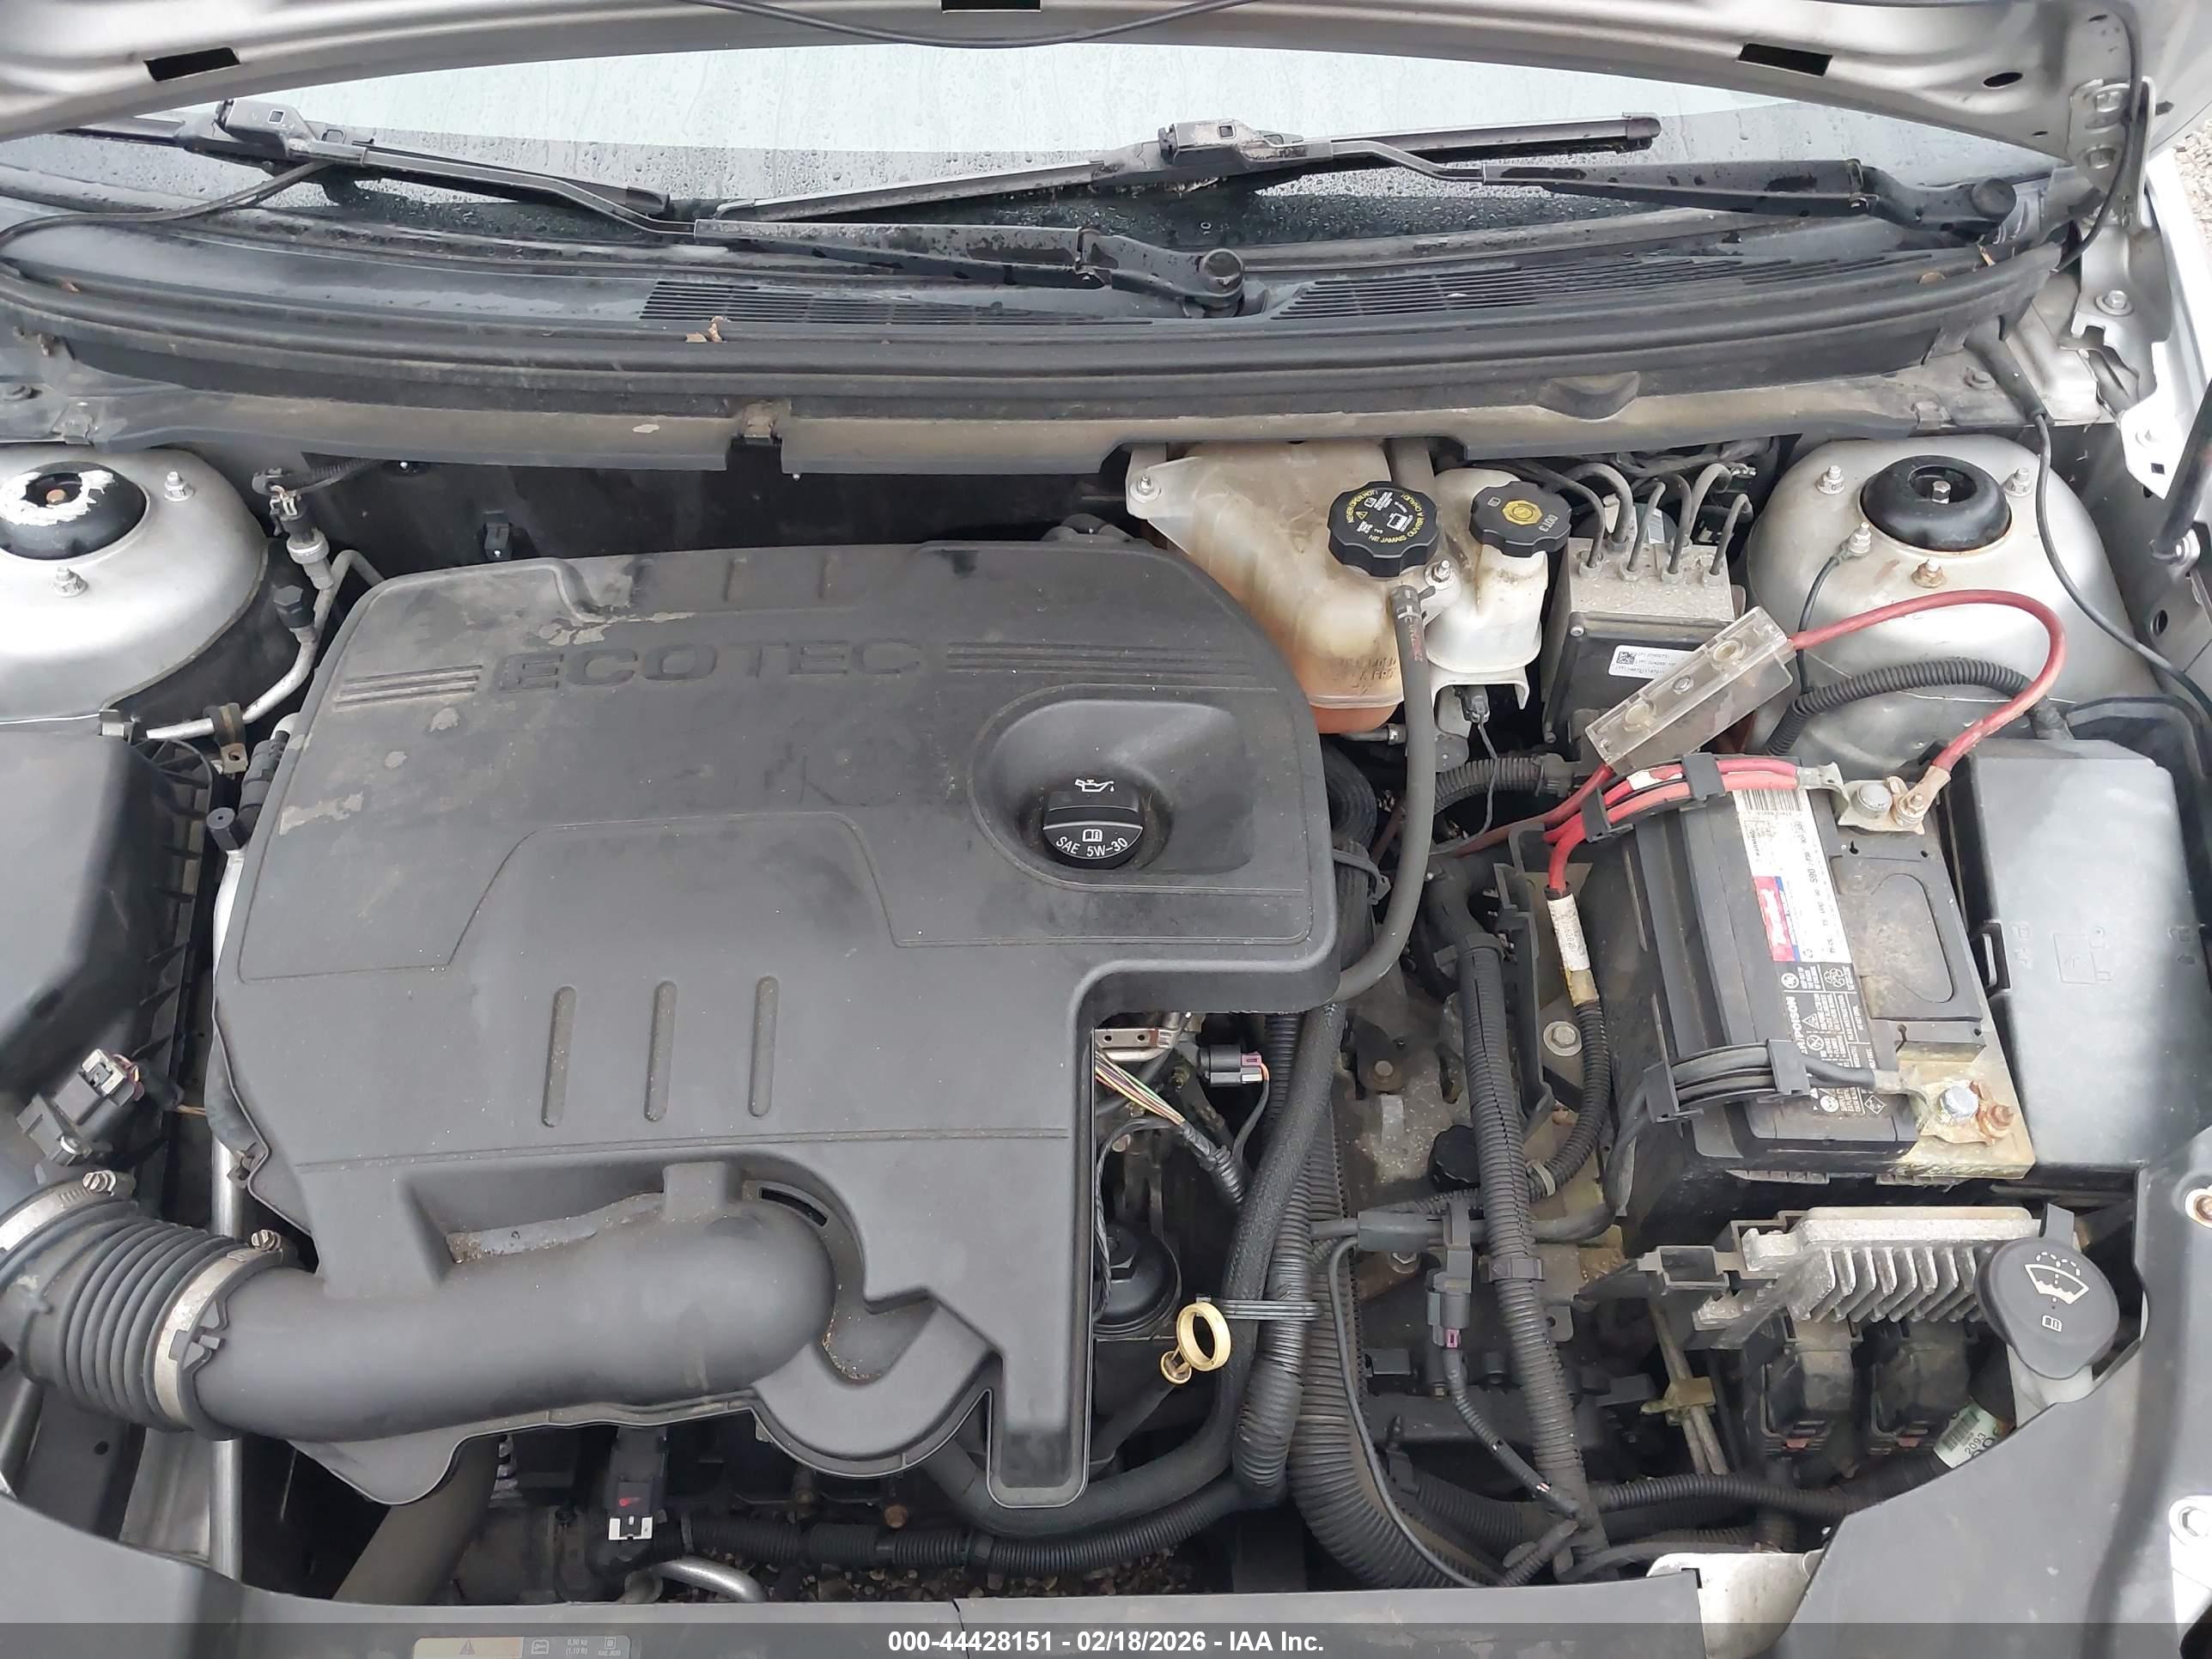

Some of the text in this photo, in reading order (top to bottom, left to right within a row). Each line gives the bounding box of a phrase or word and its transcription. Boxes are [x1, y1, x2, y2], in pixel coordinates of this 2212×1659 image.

[490, 638, 921, 694] ECOTEC
[1056, 836, 1127, 857] SAE 5W-30
[1965, 1432, 1986, 1455] 2093
